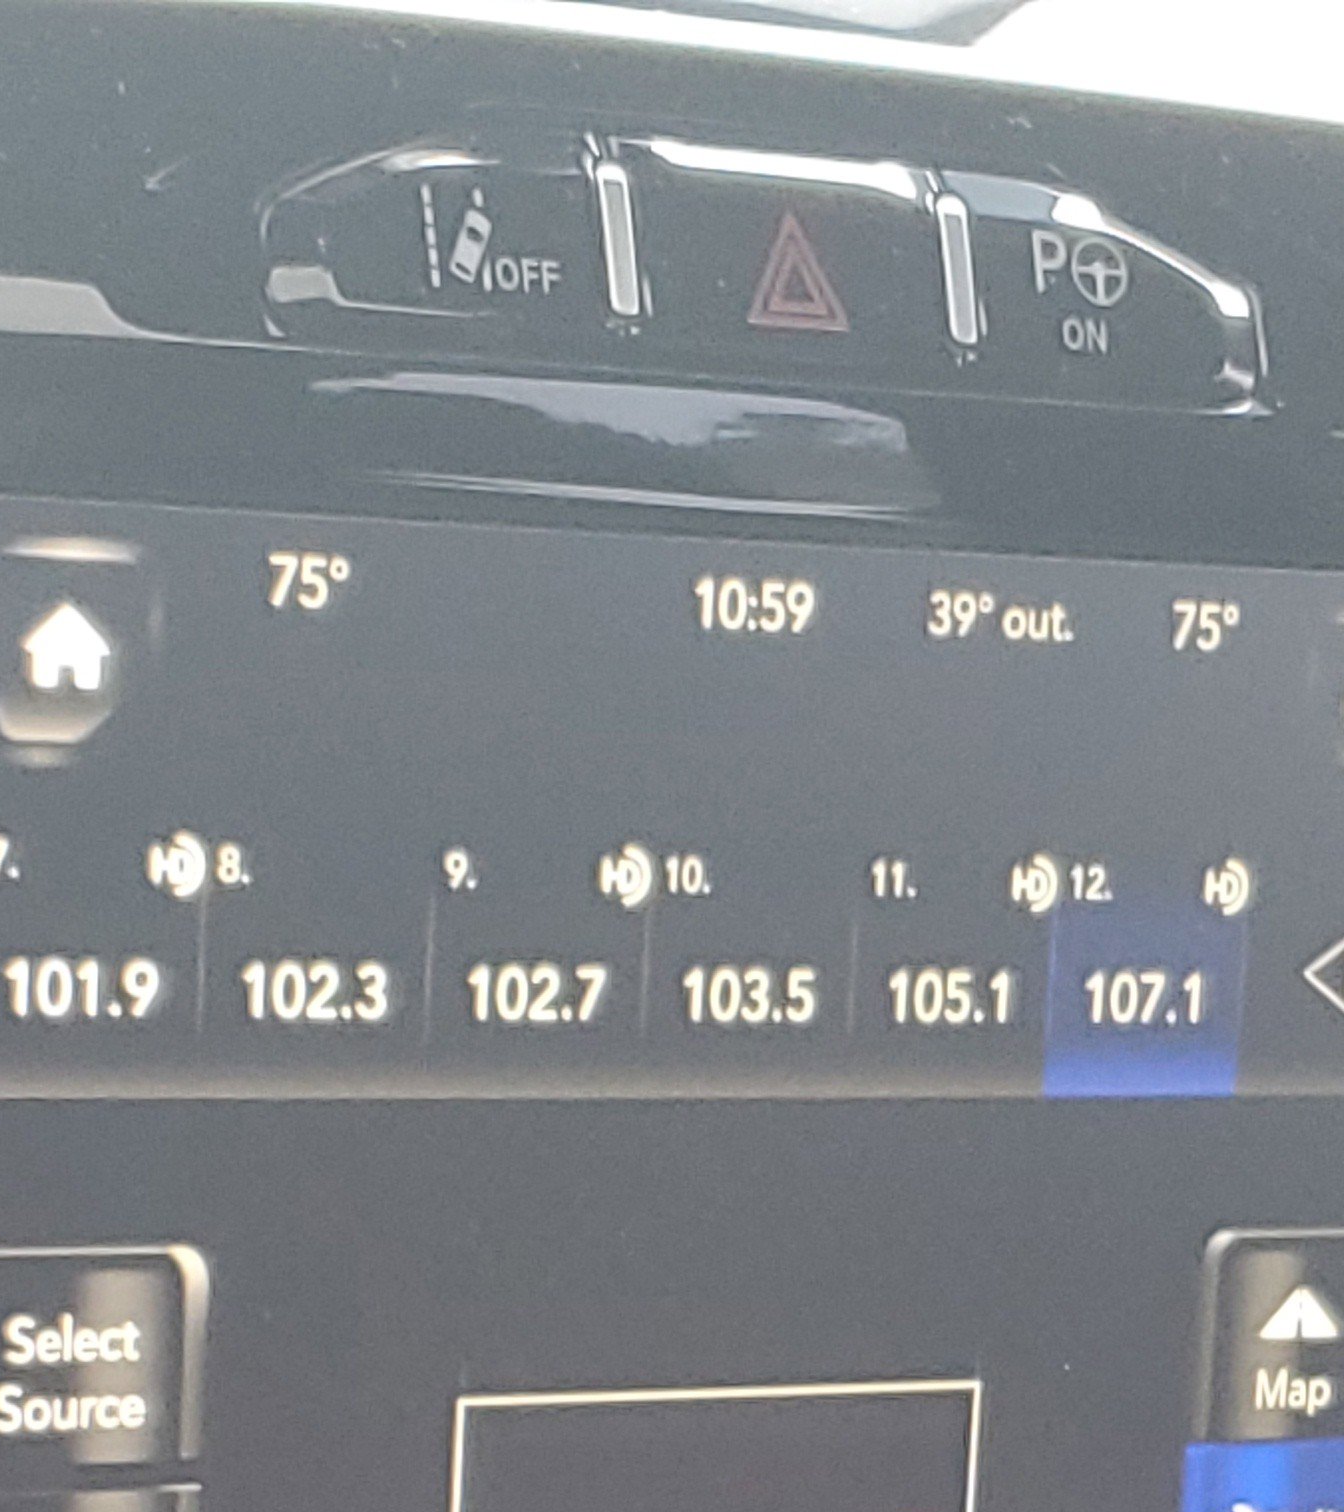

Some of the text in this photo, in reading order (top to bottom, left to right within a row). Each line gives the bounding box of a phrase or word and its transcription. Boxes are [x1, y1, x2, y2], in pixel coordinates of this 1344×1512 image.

[496, 257, 561, 295] OFF
[1030, 228, 1067, 294] P
[1061, 318, 1108, 355] ON
[268, 550, 352, 610] 75°
[694, 577, 816, 634] 10:59
[927, 589, 1075, 644] 39° out.
[1171, 597, 1241, 653] 75°
[216, 842, 252, 886] 8.
[443, 848, 478, 891] 9.
[665, 853, 712, 896] 10.
[870, 857, 918, 900] 11.
[1069, 862, 1114, 903] 12.
[3, 957, 159, 1017] 101.9
[242, 961, 388, 1021] 102.3
[467, 964, 608, 1023] 102.7
[681, 966, 818, 1024] 103.5
[888, 967, 1014, 1025] 105.1
[1084, 969, 1208, 1025] 107.1
[1, 1312, 141, 1366] Select
[1254, 1369, 1331, 1416] Map
